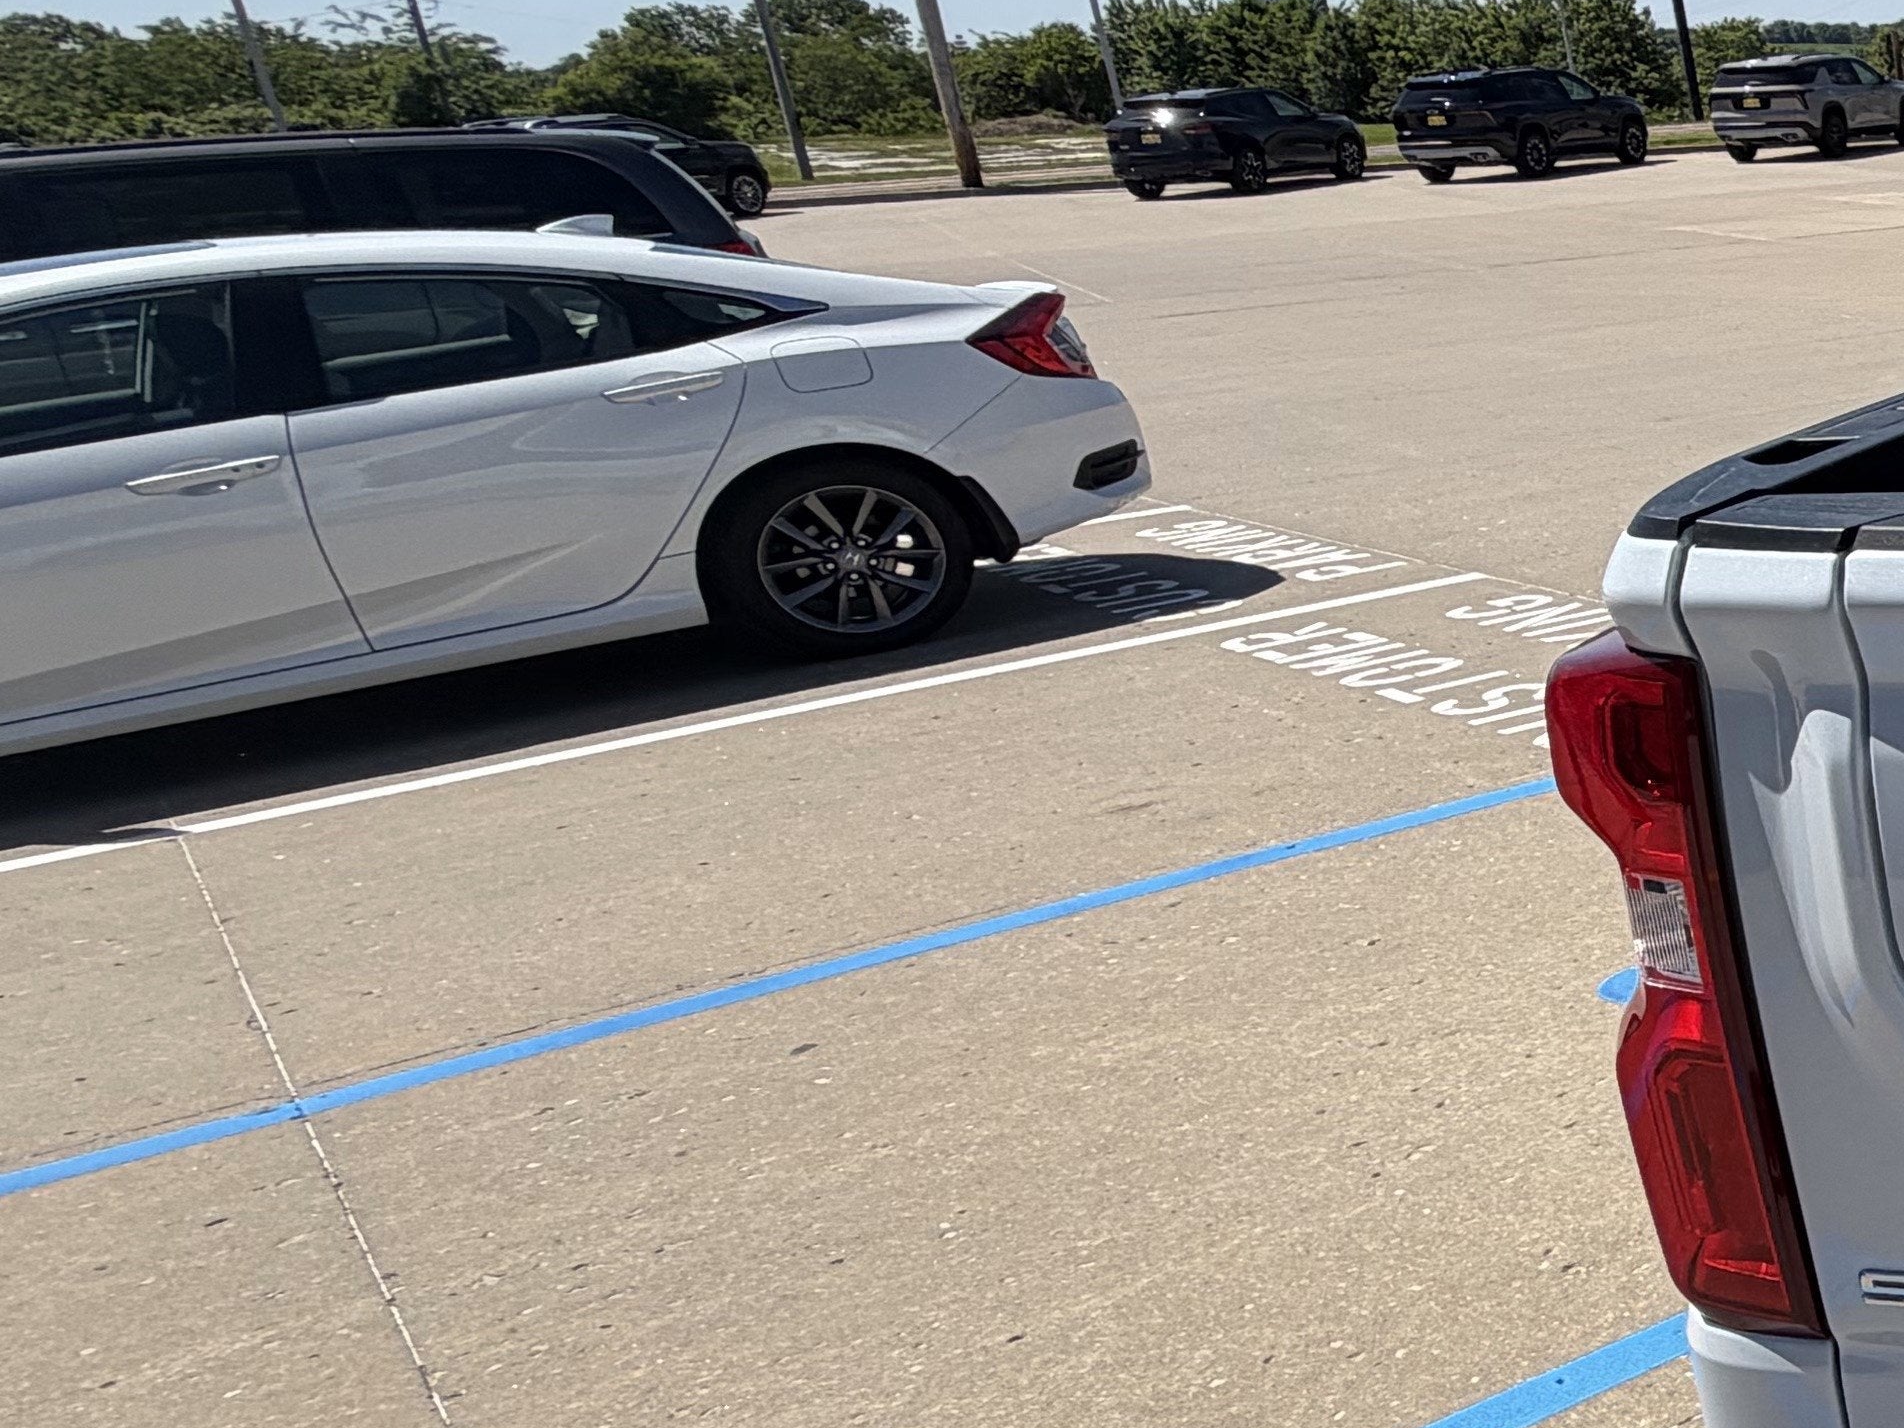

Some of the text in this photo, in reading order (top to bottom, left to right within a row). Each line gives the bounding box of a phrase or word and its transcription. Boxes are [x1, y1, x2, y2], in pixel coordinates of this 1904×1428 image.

[973, 544, 1243, 622] CUSTOME
[1135, 520, 1408, 582] PARKING
[1220, 621, 1551, 749] USTOMER
